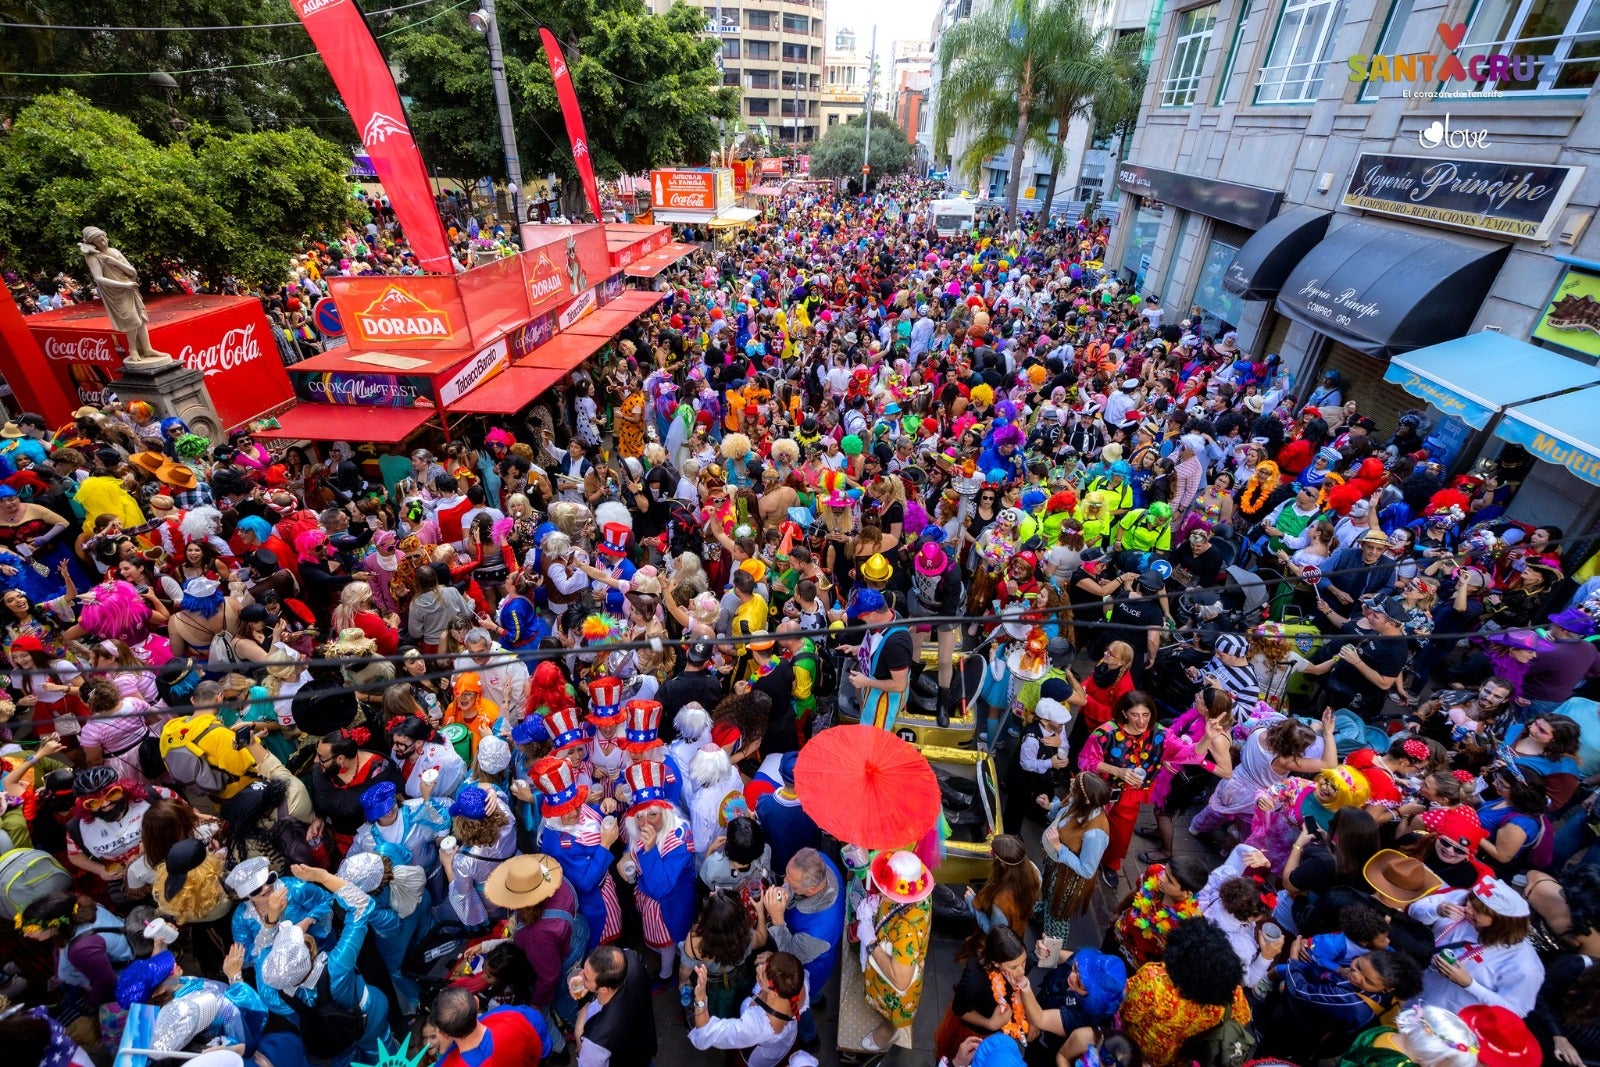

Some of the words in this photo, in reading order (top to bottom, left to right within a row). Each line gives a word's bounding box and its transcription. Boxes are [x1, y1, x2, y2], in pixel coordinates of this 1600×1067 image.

[1352, 165, 1416, 200] Joyería
[1359, 198, 1389, 212] COMPRO
[1389, 201, 1406, 214] ORO
[1411, 207, 1475, 226] REPARACIONES
[531, 274, 562, 299] DORADA
[361, 317, 448, 335] DORADA
[1307, 301, 1332, 318] COMPRO
[1335, 314, 1351, 326] ORO
[44, 336, 111, 361] Coca-Cola
[1120, 602, 1141, 618] POLICE
